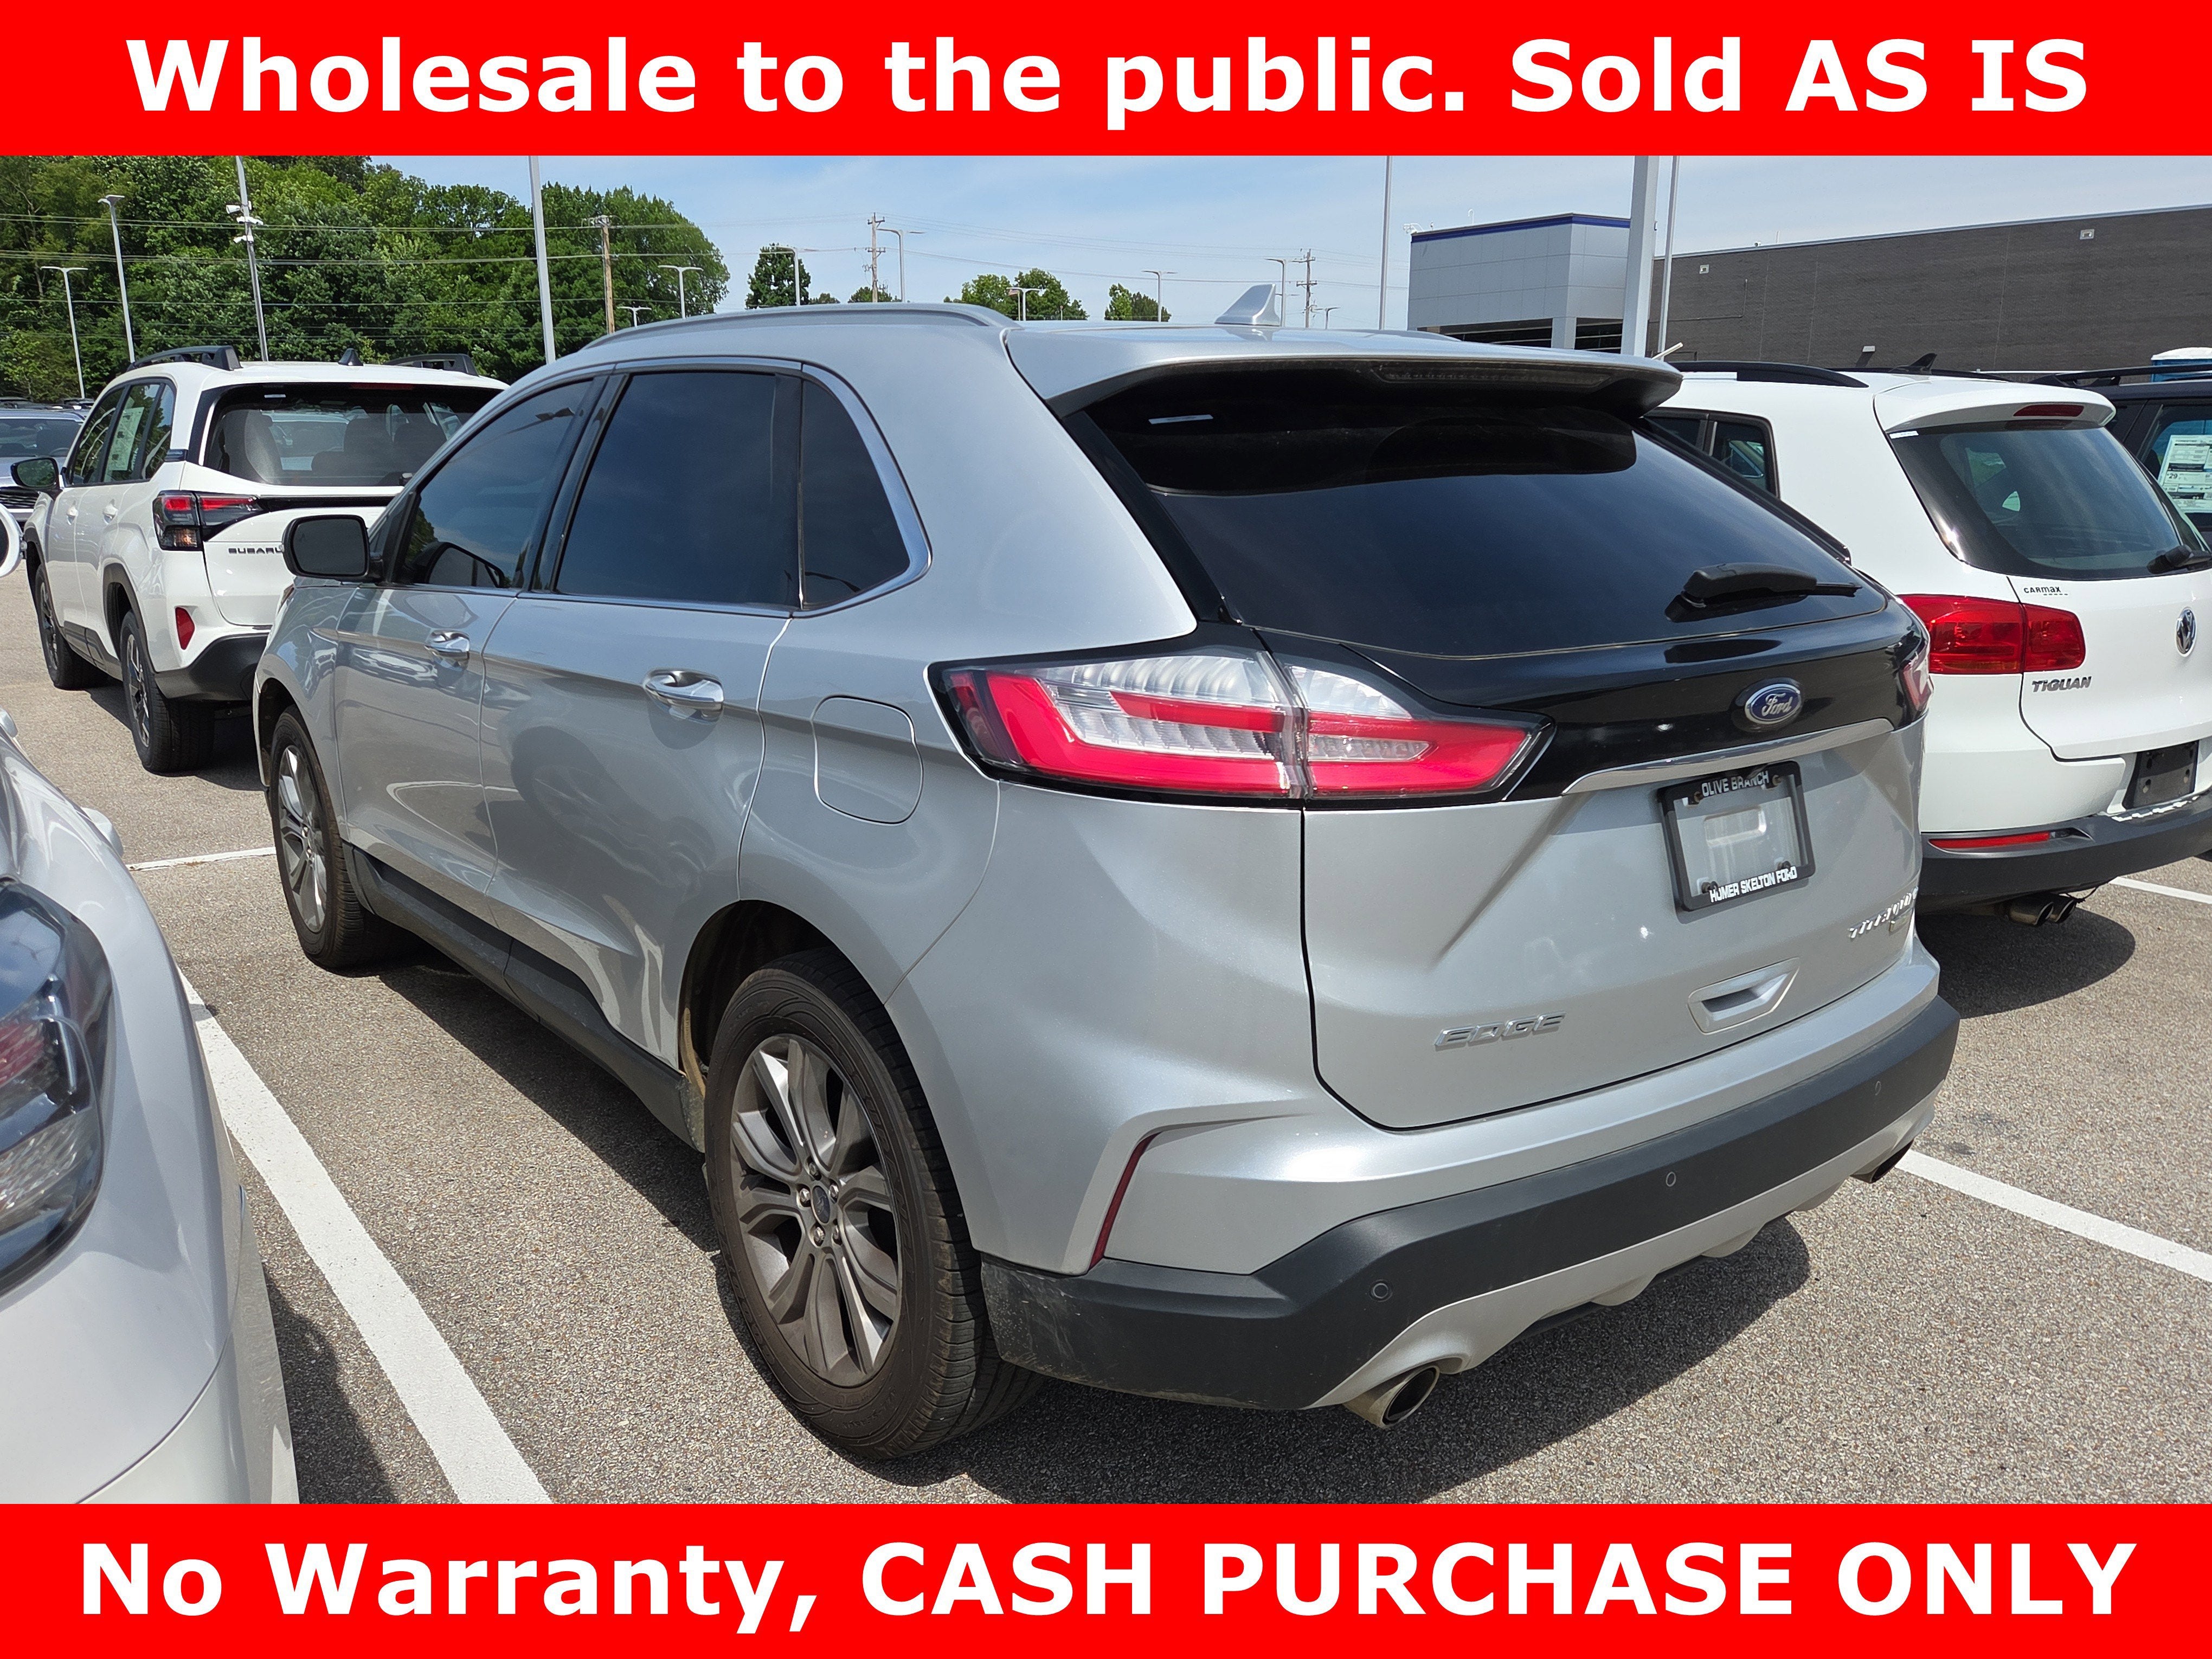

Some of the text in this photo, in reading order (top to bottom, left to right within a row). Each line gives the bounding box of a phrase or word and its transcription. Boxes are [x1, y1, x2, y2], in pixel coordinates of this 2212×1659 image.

[2032, 676, 2092, 692] TIGUAN
[1762, 692, 1793, 717] Ford
[1702, 769, 1769, 797] OLIVE BRANCH
[1740, 872, 1775, 894] SKELTON
[1434, 1011, 1566, 1046] EDGE
